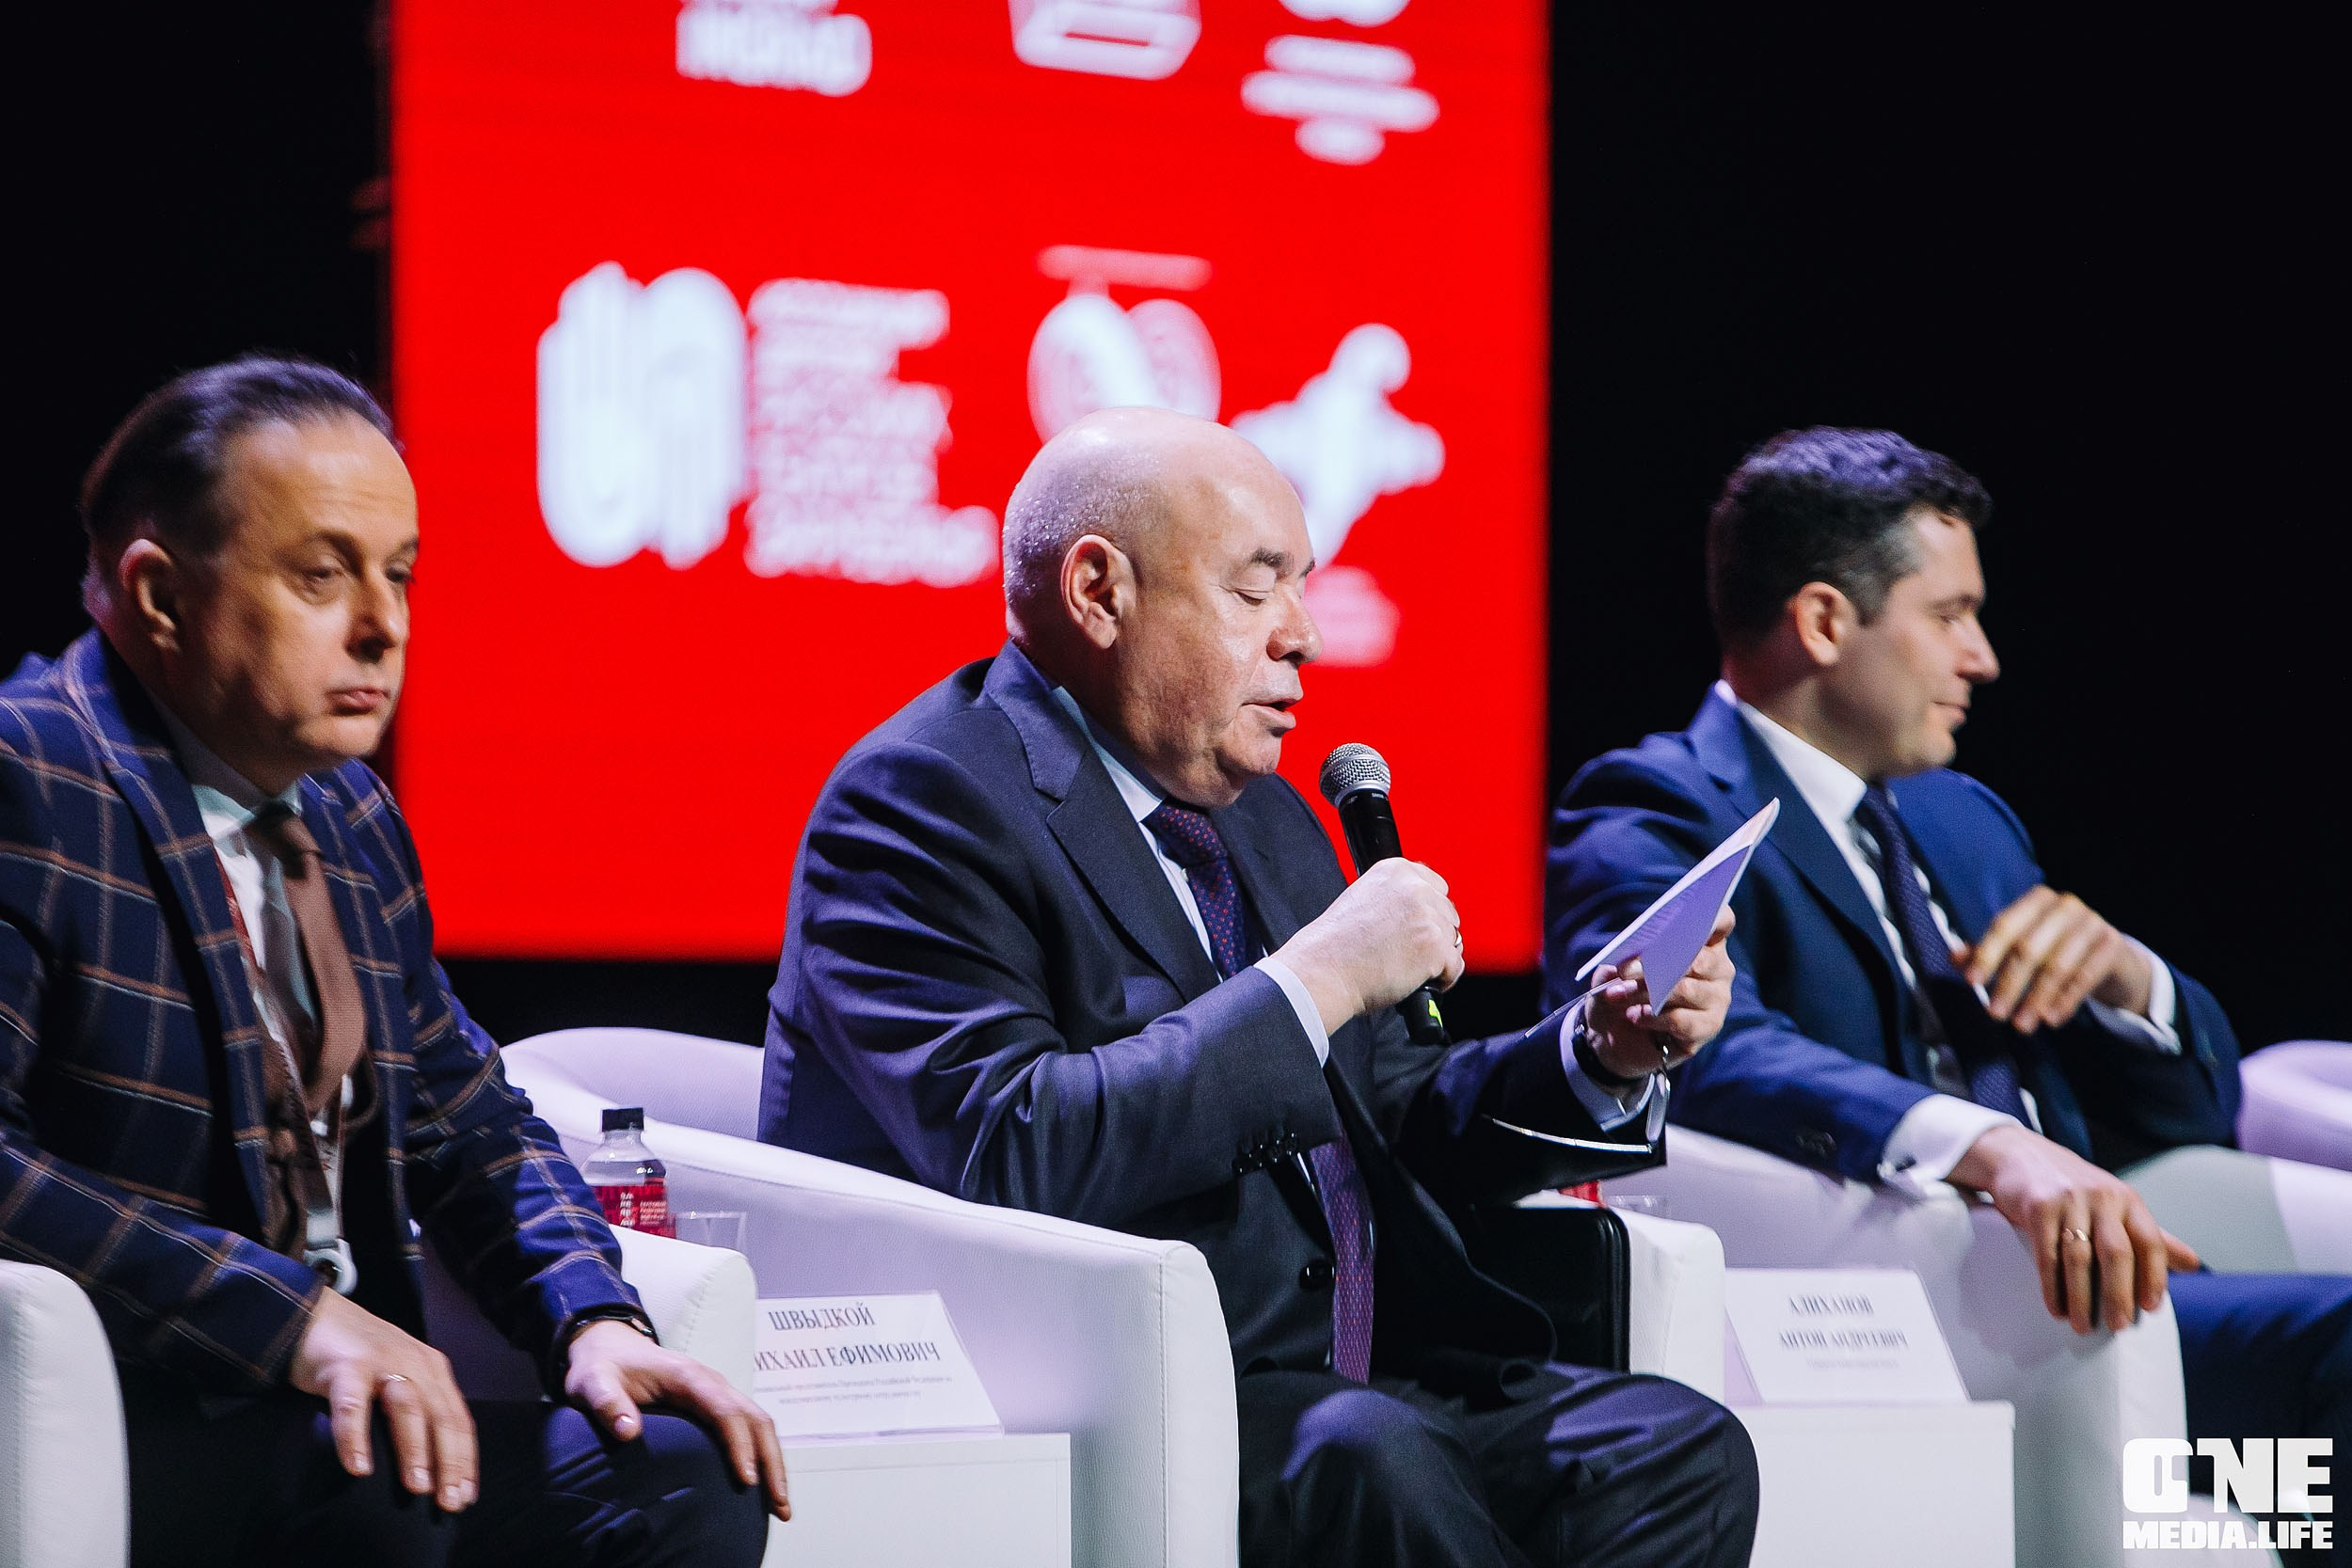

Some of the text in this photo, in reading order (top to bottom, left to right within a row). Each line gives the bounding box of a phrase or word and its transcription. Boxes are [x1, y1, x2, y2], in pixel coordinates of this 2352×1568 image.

[768, 1301, 875, 1332] ШВЫДКОЙ
[754, 1341, 942, 1371] ИХАИЛ ЕФИМОВИЧ
